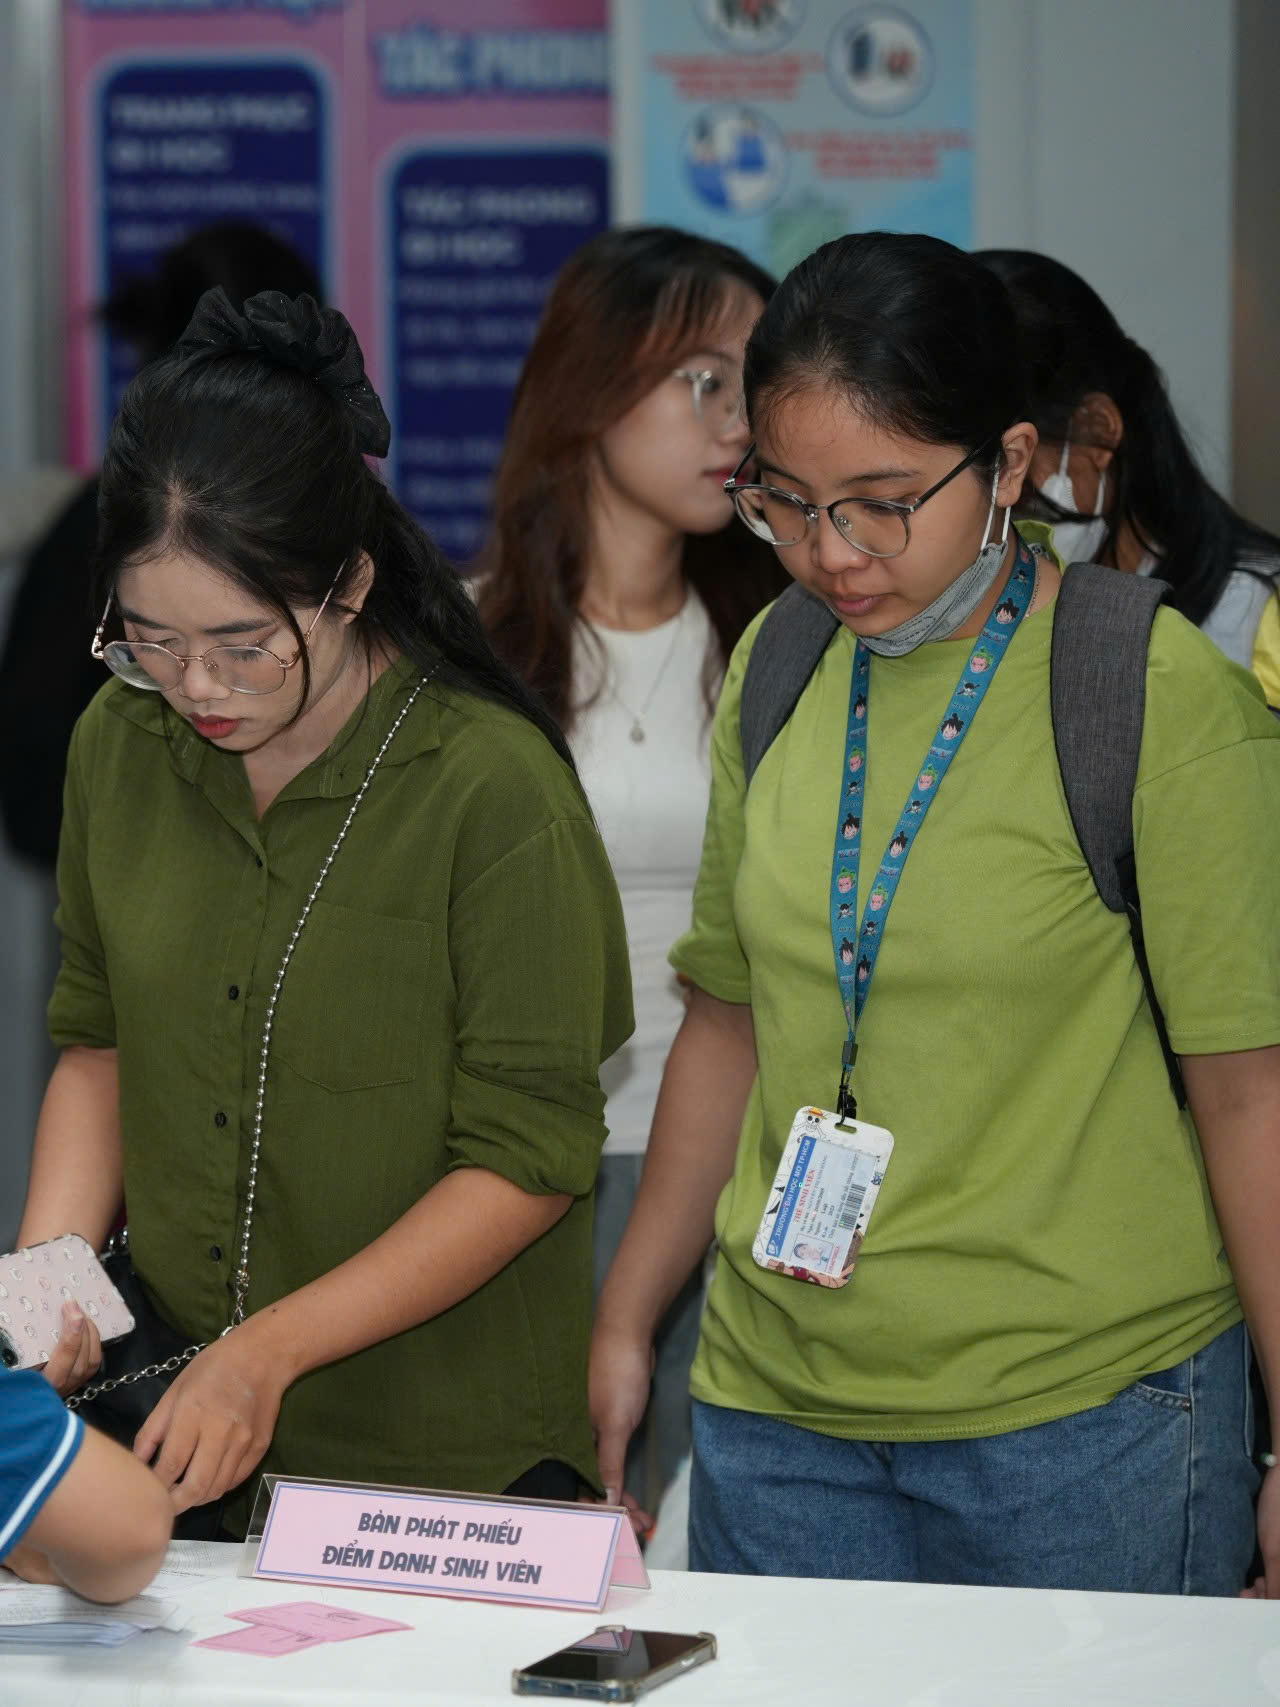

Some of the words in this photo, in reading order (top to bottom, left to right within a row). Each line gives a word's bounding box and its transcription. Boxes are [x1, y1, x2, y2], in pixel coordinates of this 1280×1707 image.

[357, 1510, 401, 1535] BÀN
[404, 1515, 460, 1540] PHÁT
[463, 1519, 523, 1546] PHIẾU
[321, 1539, 375, 1569] ĐIỂM
[378, 1550, 438, 1575] DANH
[440, 1556, 490, 1580] SINH
[496, 1559, 543, 1585] VIÊN
